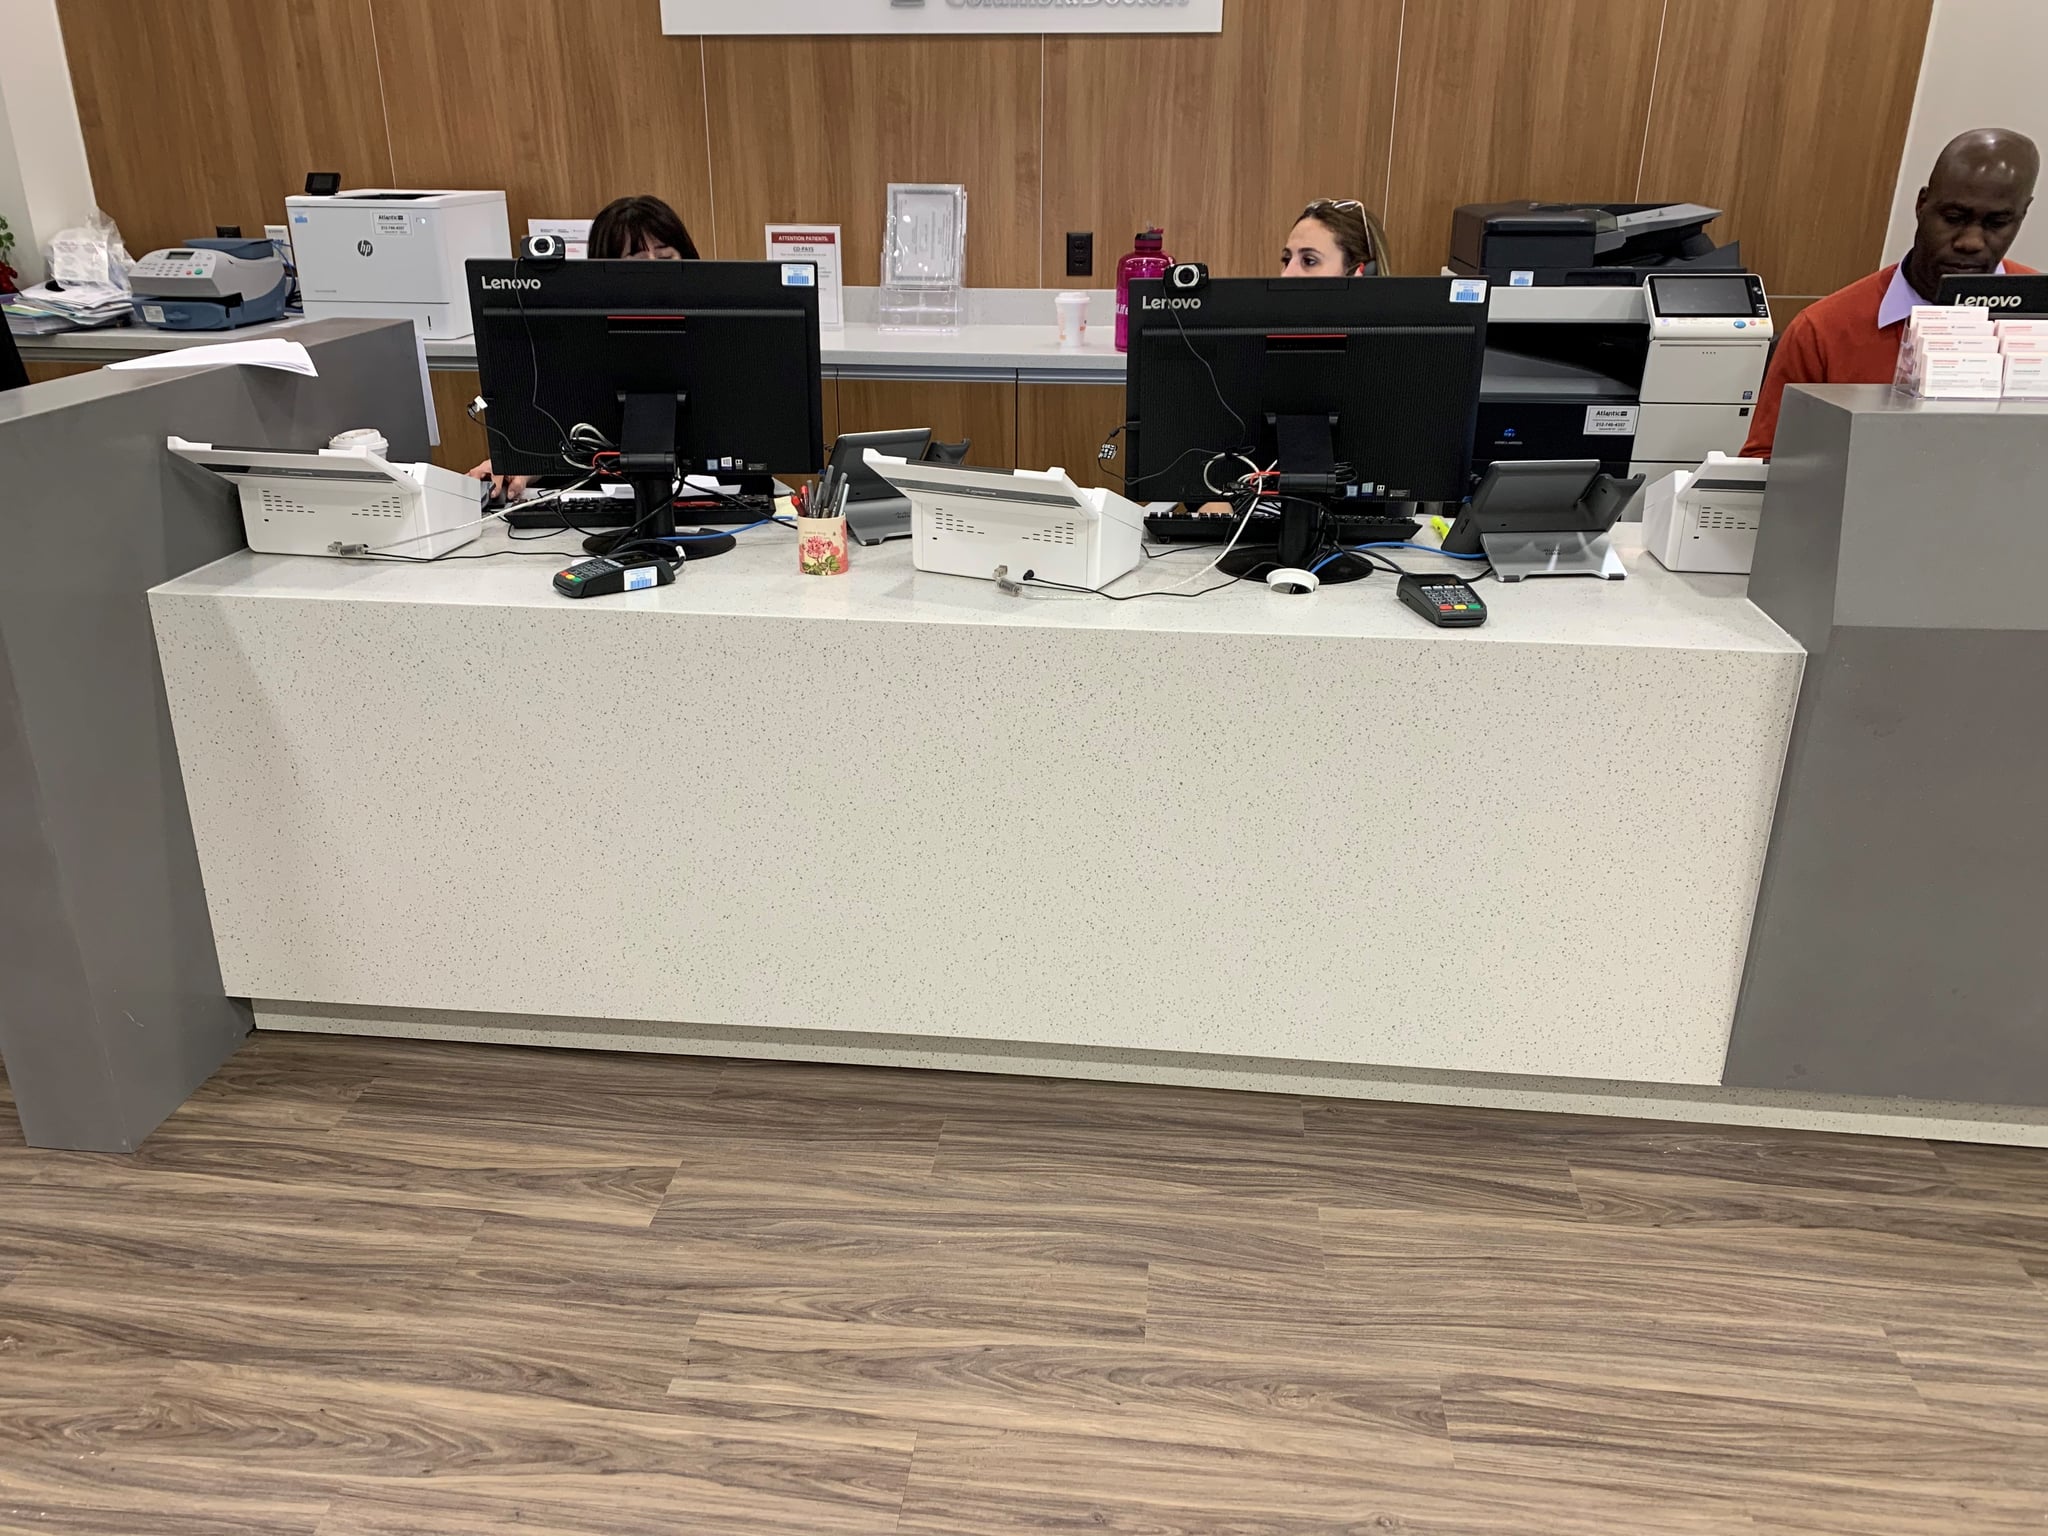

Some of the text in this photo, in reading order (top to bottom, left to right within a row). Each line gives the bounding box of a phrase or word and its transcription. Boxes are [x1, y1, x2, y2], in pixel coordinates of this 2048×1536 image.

[358, 240, 373, 257] hp
[481, 275, 541, 289] Lenovo
[1142, 295, 1201, 310] Lenovo
[1955, 293, 2022, 307] Lenovo
